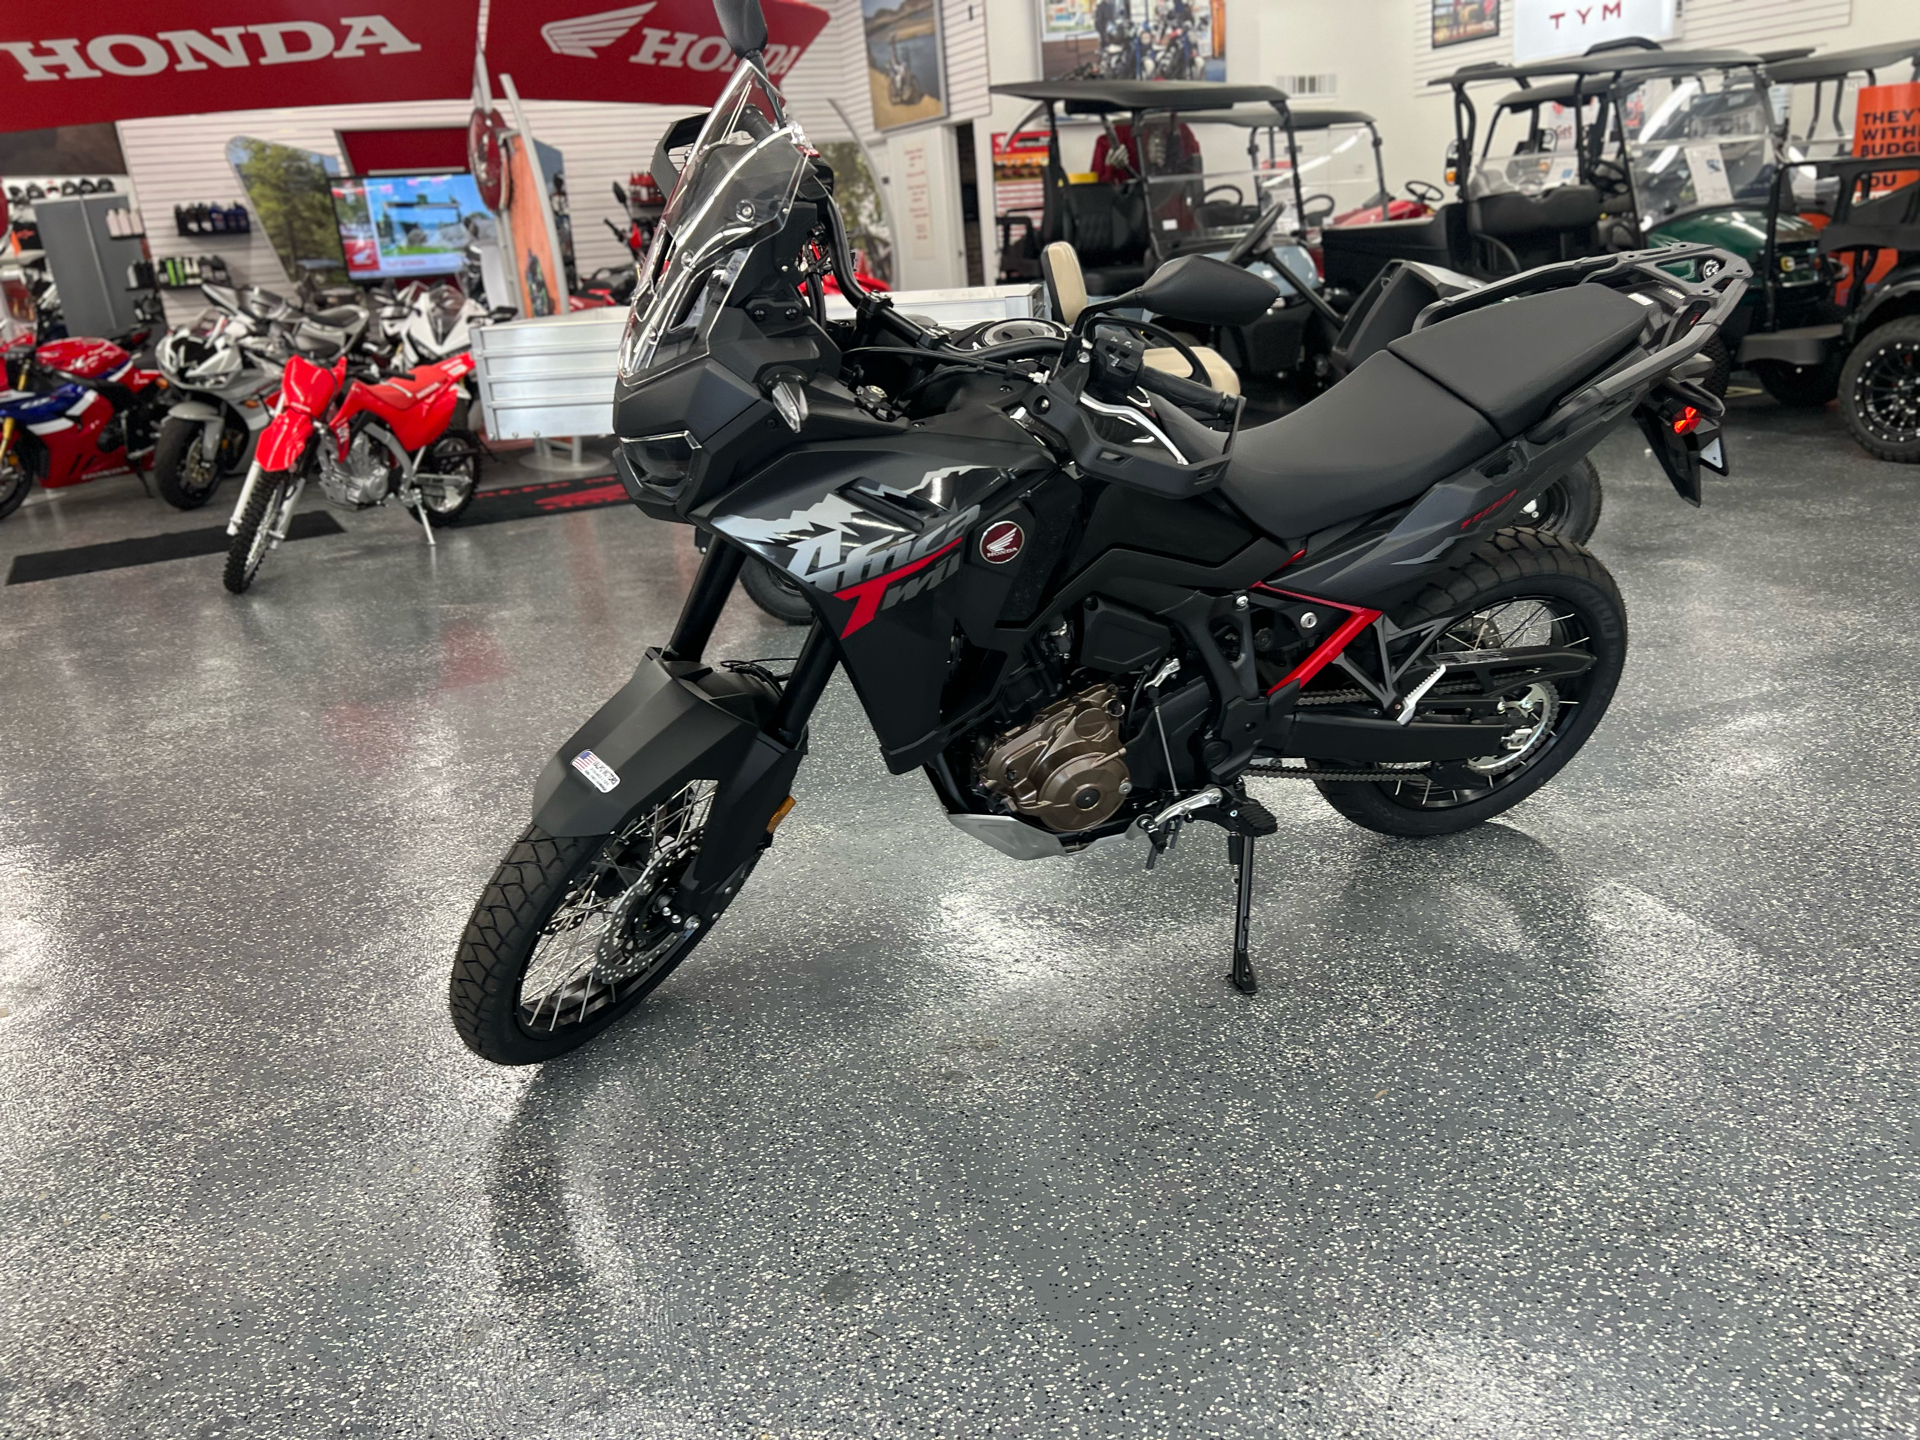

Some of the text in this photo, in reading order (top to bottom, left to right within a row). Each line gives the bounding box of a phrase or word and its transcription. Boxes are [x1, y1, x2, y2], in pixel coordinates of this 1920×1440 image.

[1549, 1, 1622, 30] TYM
[0, 14, 421, 82] HONDA
[629, 27, 800, 76] HODA
[1868, 173, 1897, 188] OU
[986, 546, 1018, 558] HONDA
